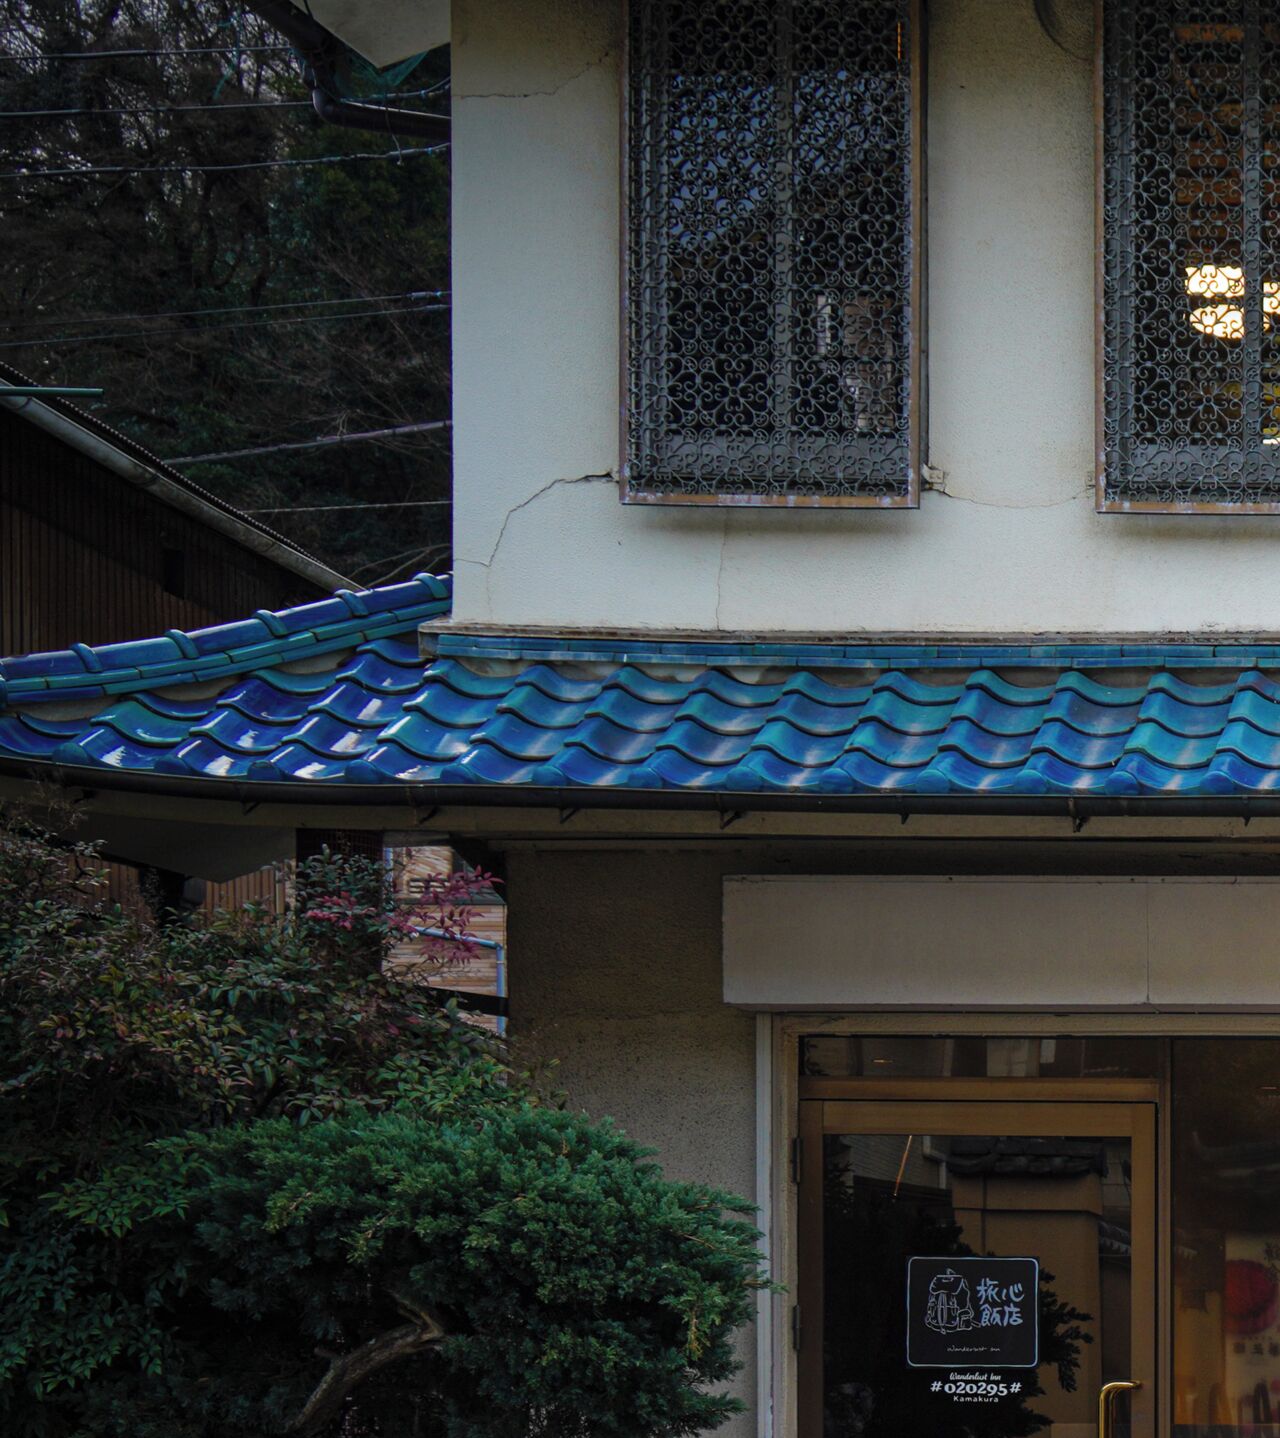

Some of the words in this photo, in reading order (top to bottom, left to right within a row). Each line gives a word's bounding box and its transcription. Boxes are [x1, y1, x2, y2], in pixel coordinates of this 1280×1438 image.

[976, 1277, 1025, 1304] 旅心
[979, 1302, 1024, 1327] 飯店
[949, 1371, 987, 1381] Wanderlust
[990, 1372, 1002, 1381] Inn
[953, 1395, 999, 1403] Kamakura
